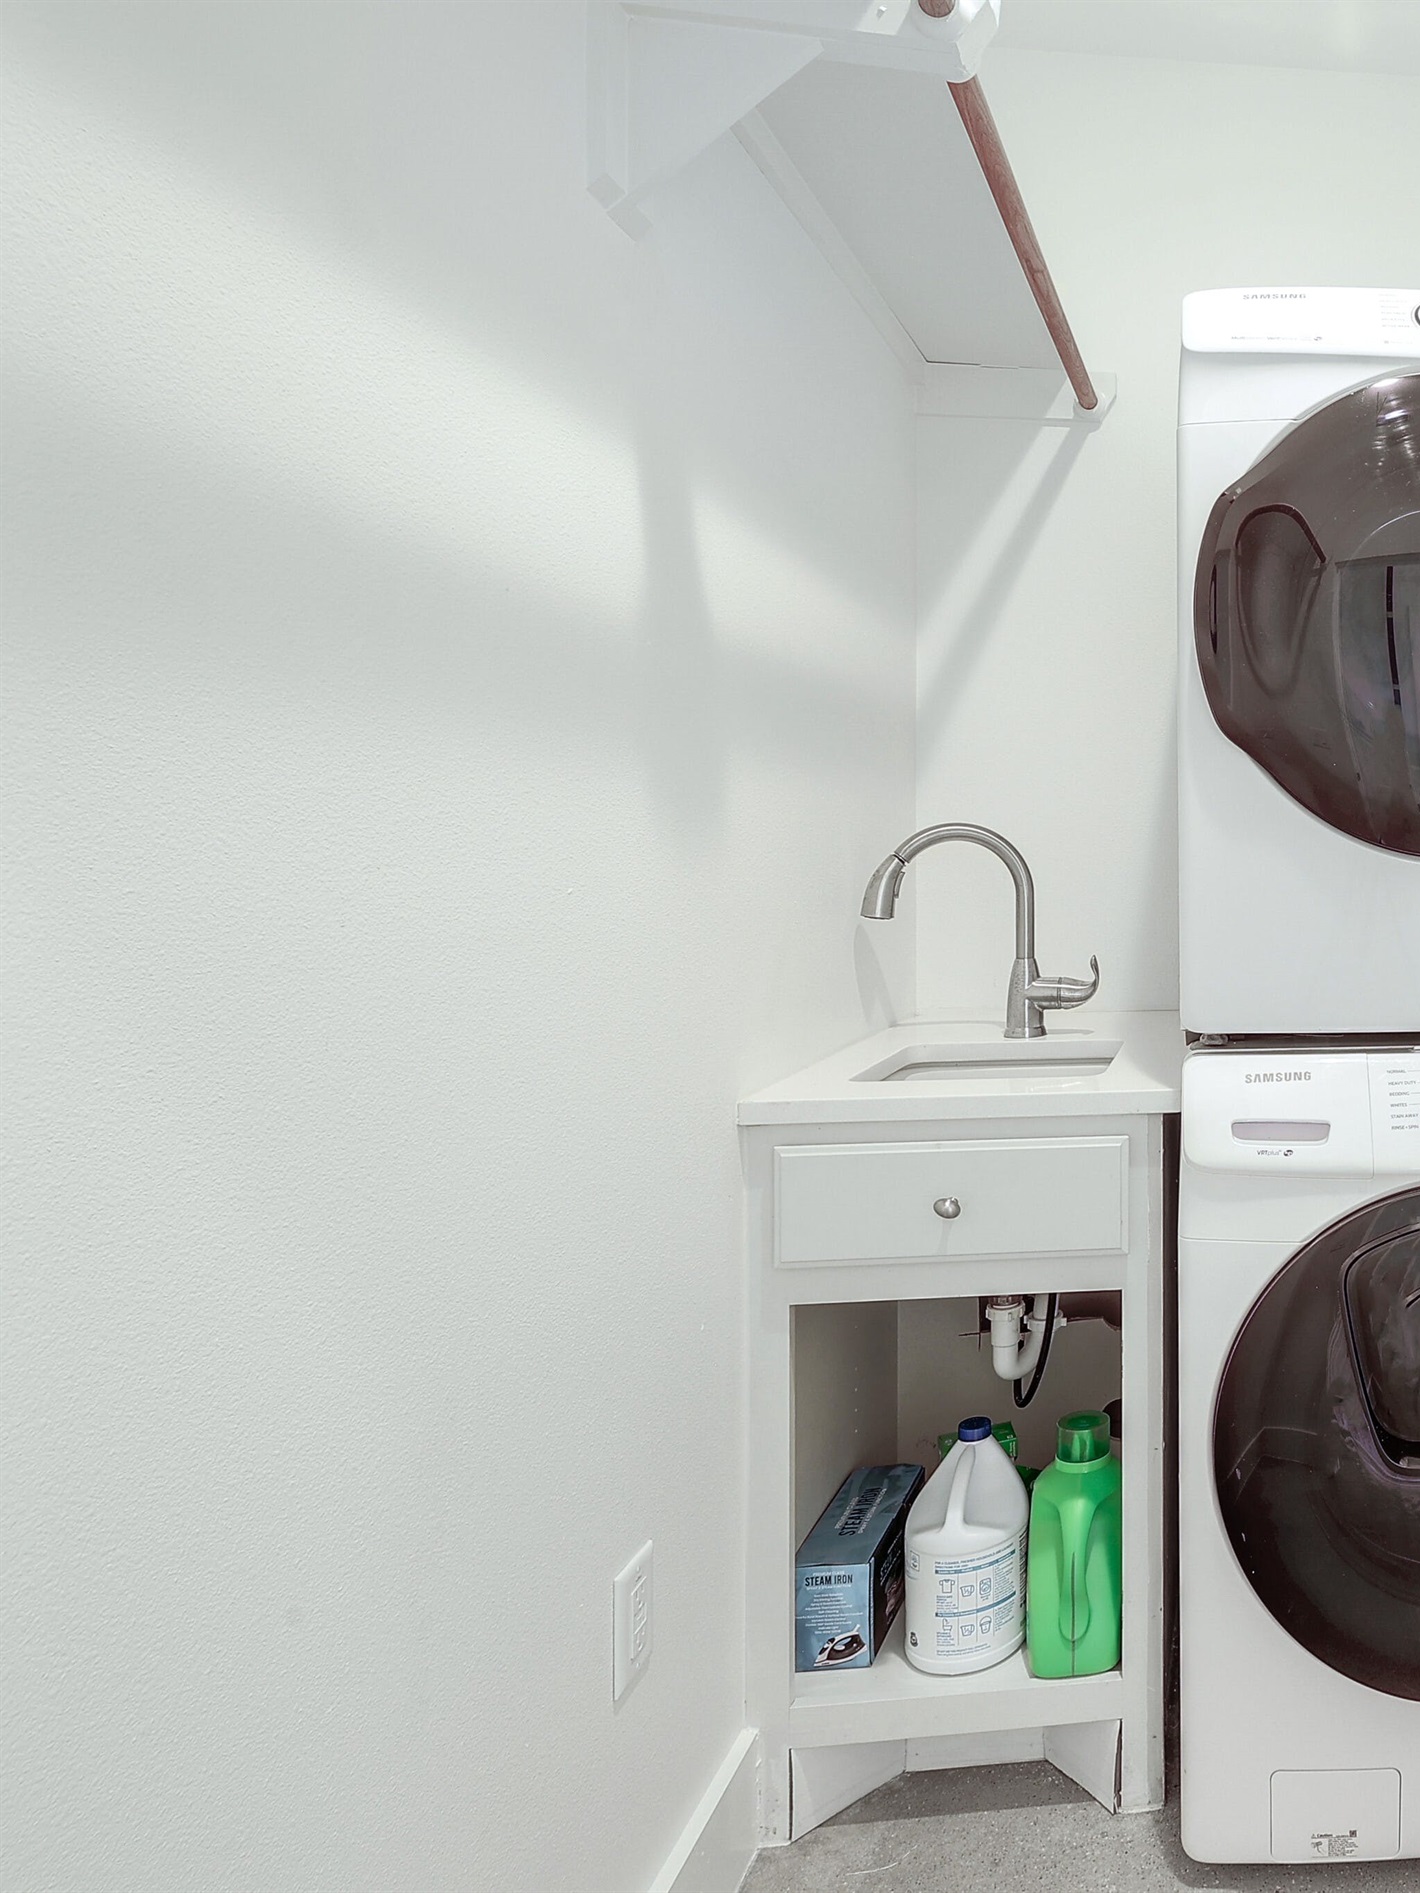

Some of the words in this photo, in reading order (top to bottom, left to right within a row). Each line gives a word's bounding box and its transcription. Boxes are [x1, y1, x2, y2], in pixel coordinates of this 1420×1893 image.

[1245, 1071, 1312, 1084] SAMSUNG
[839, 1508, 869, 1536] STEAM
[856, 1487, 882, 1506] IRON
[805, 1576, 832, 1587] STEAM
[834, 1575, 853, 1584] IRON
